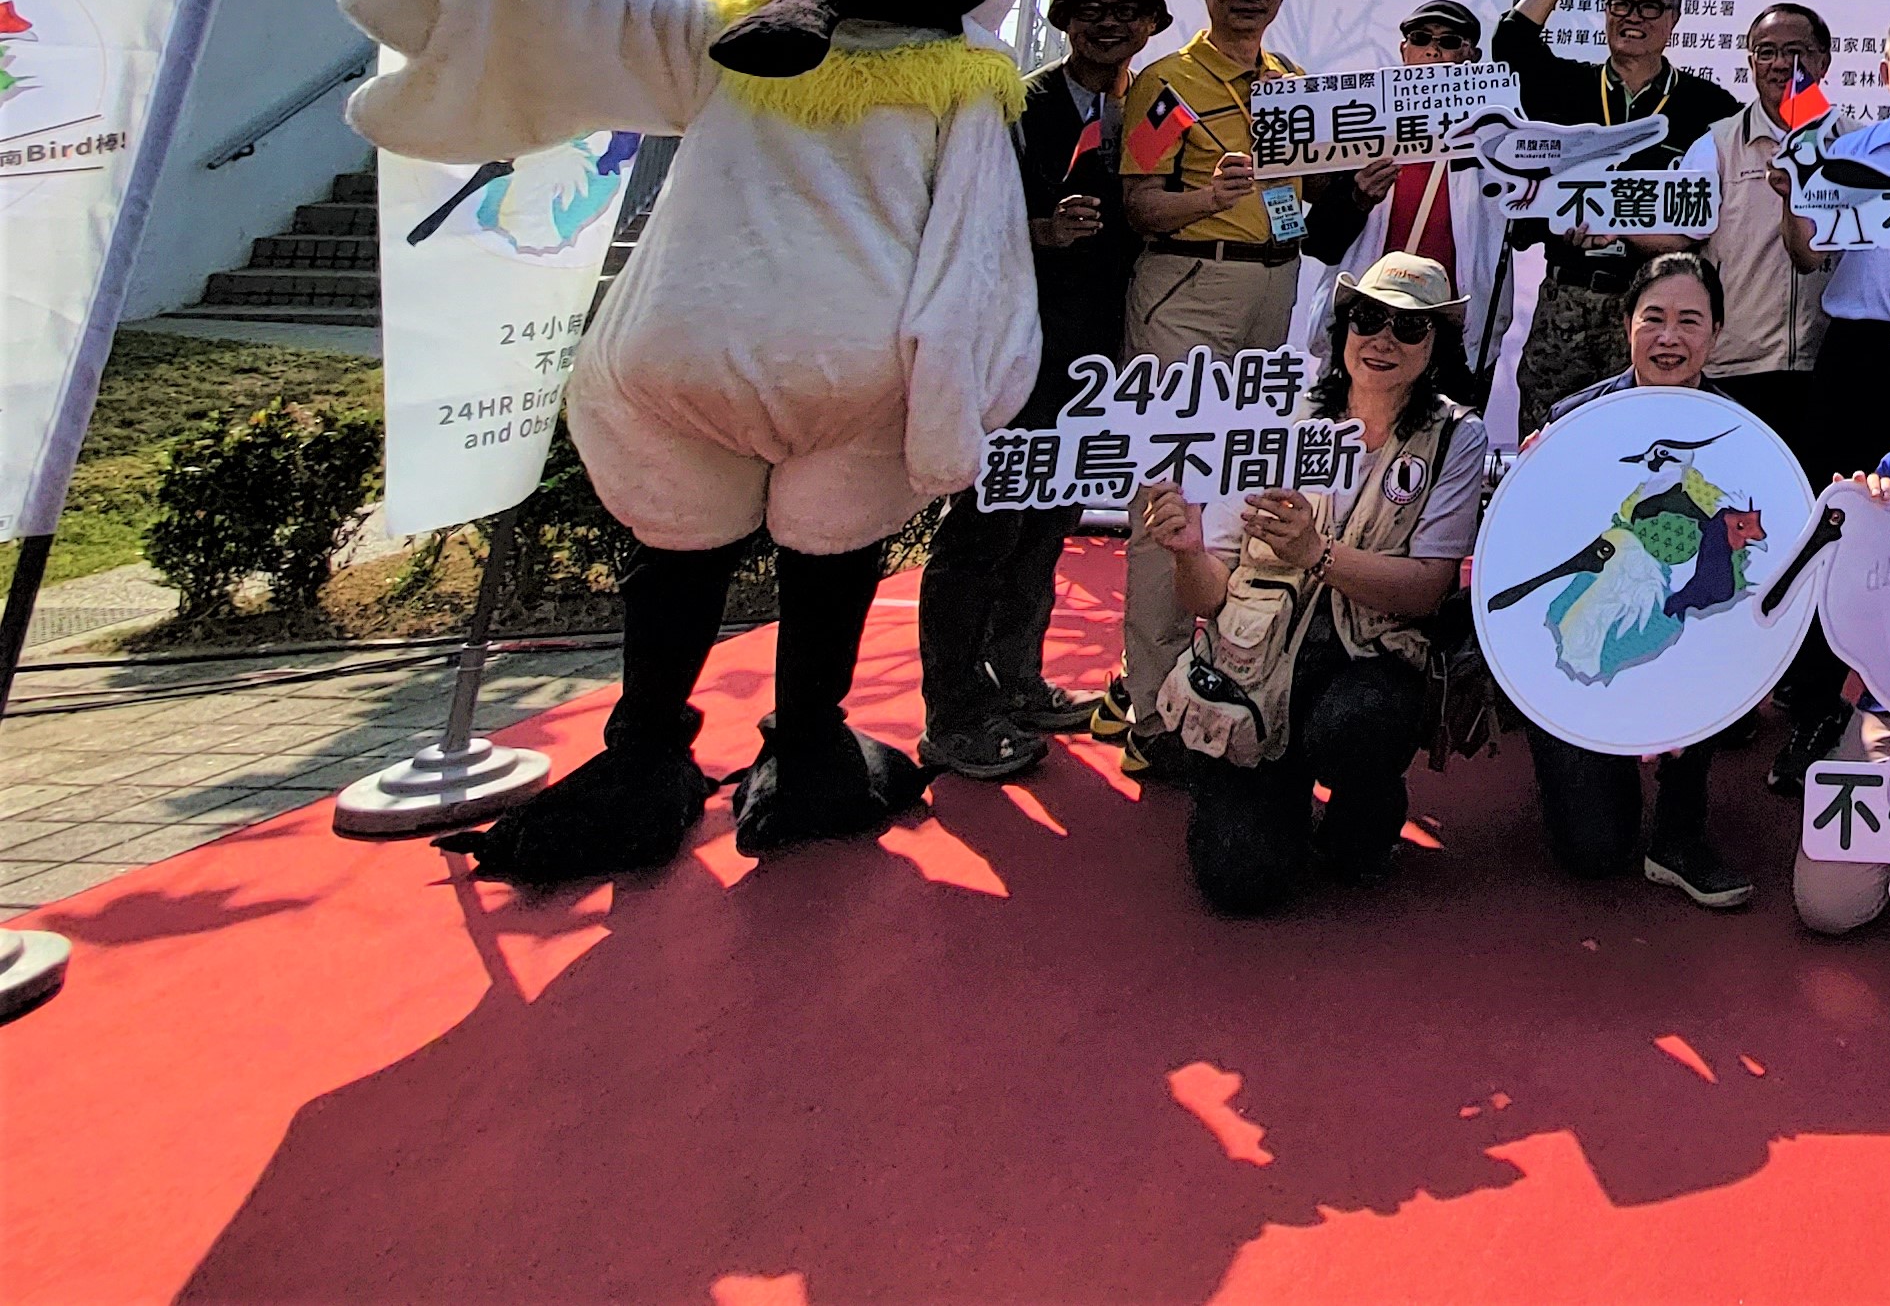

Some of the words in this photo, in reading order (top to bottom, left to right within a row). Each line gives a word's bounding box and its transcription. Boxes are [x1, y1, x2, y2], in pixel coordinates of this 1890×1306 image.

[1252, 81, 1296, 96] 2023
[1304, 73, 1376, 93] 臺灣國際
[1393, 67, 1435, 82] 2023
[1445, 62, 1506, 77] Taiwan
[1394, 75, 1517, 97] International
[1394, 94, 1487, 112] Birdathon
[1556, 177, 1713, 228] 不驚嚇
[1066, 351, 1304, 419] 24小時
[438, 396, 513, 425] 24HR
[464, 421, 512, 449] and
[983, 424, 1365, 504] 觀鳥不間斷
